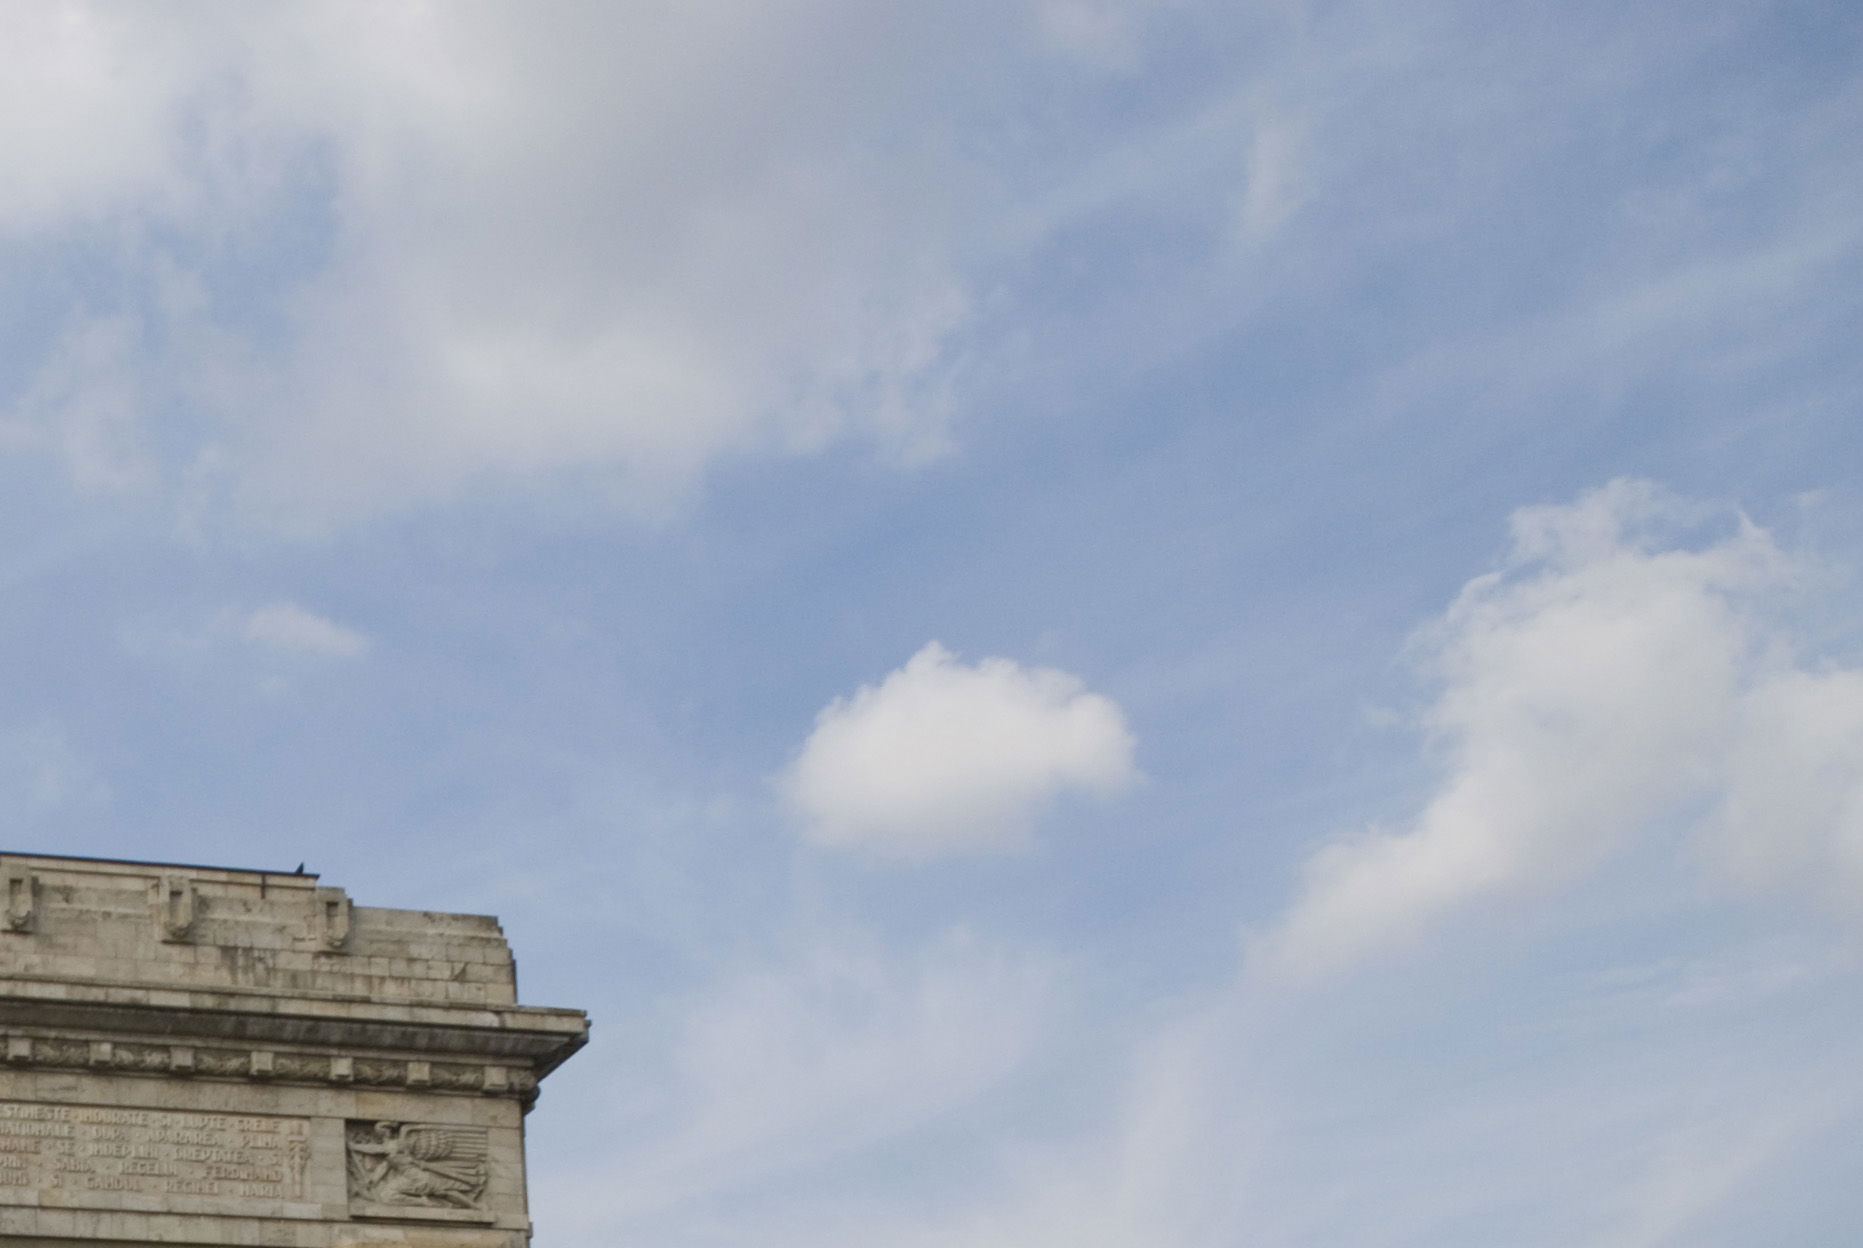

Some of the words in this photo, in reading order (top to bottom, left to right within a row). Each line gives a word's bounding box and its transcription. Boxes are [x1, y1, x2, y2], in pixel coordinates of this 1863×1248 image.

[237, 1117, 281, 1133] GRELE
[56, 1141, 76, 1157] SE
[202, 1165, 284, 1183] FERDINAND
[240, 1184, 284, 1200] MARIA
